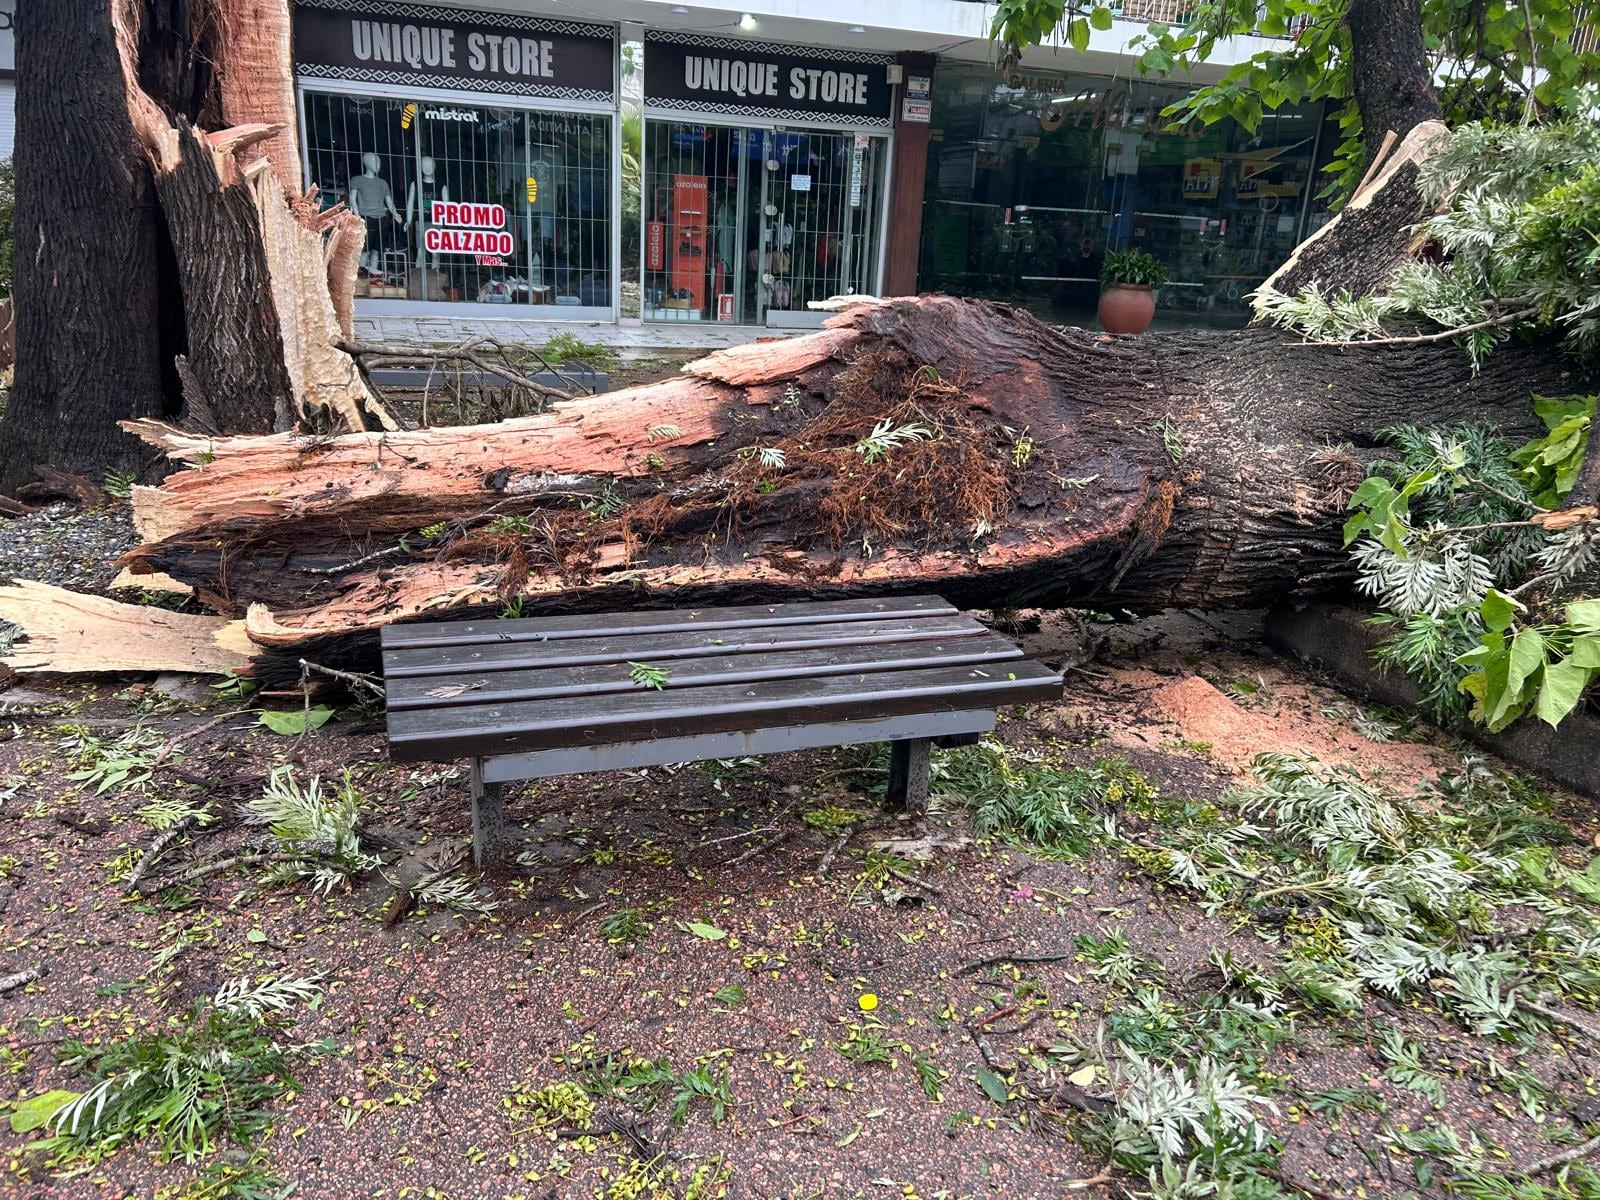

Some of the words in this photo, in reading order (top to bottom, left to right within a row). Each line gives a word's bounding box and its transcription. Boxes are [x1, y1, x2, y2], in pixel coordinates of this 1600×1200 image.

[351, 19, 457, 69] UNIQUE
[467, 32, 554, 78] STORE
[685, 55, 778, 97] UNIQUE
[789, 67, 868, 105] STORE
[424, 107, 480, 122] mistral
[676, 181, 707, 189] azaleia
[433, 203, 504, 227] PROMO
[426, 230, 511, 254] CALZADO
[651, 224, 660, 266] azaleia
[475, 254, 481, 266] Y
